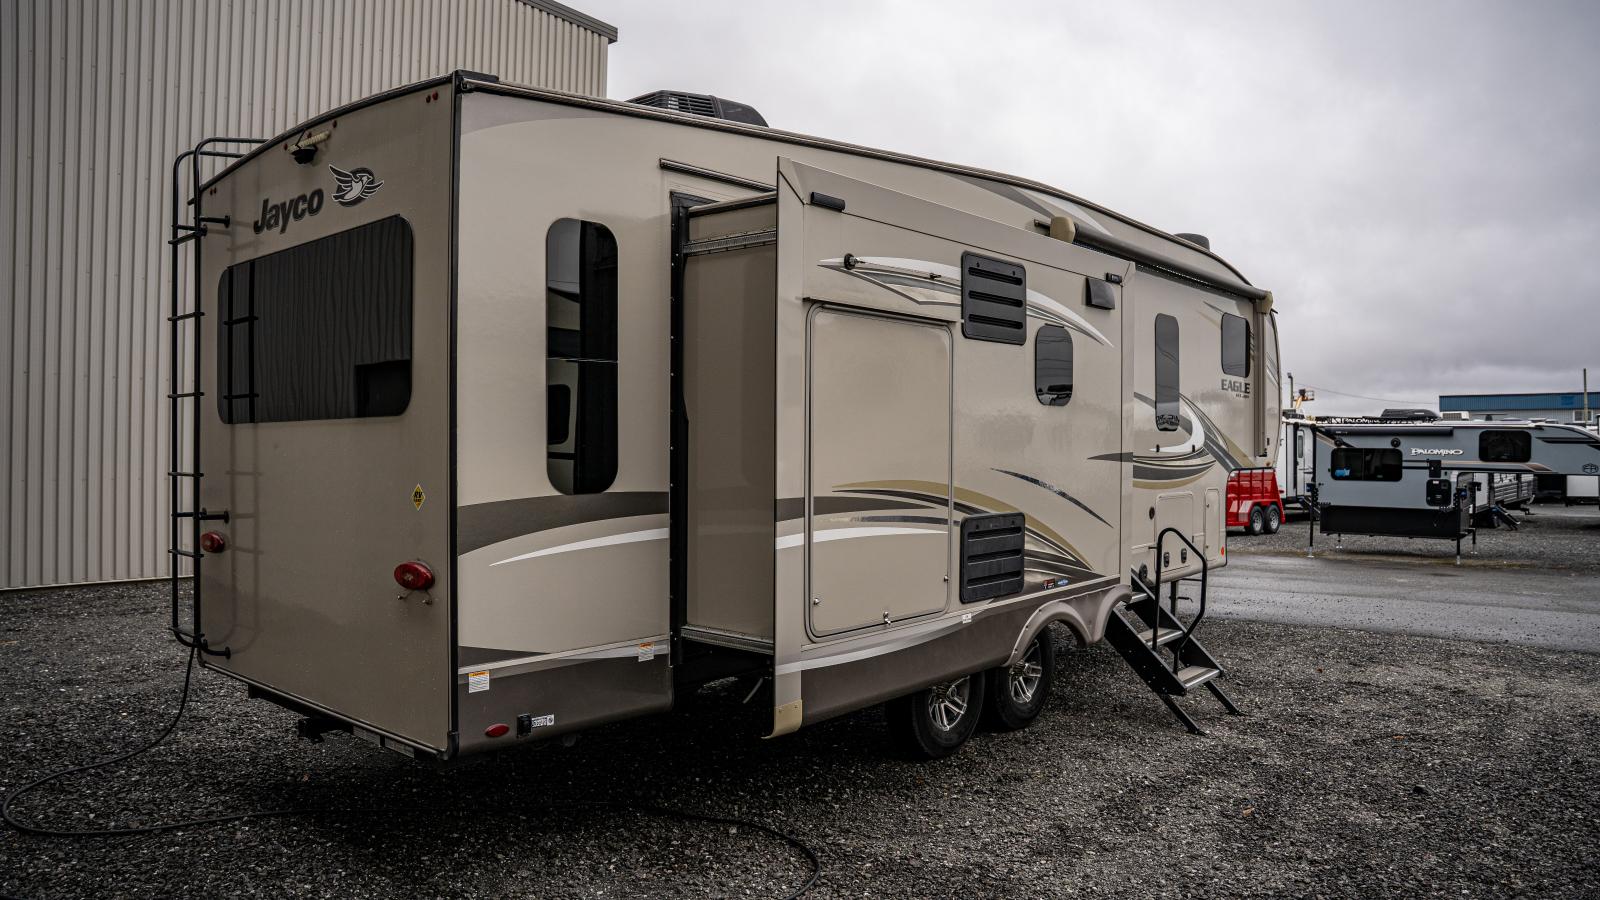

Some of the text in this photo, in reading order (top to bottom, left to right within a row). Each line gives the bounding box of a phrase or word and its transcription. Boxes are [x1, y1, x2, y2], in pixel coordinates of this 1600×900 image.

[253, 188, 324, 234] Jayco
[1221, 379, 1250, 394] EAGLE
[1411, 447, 1463, 457] PALOMINO
